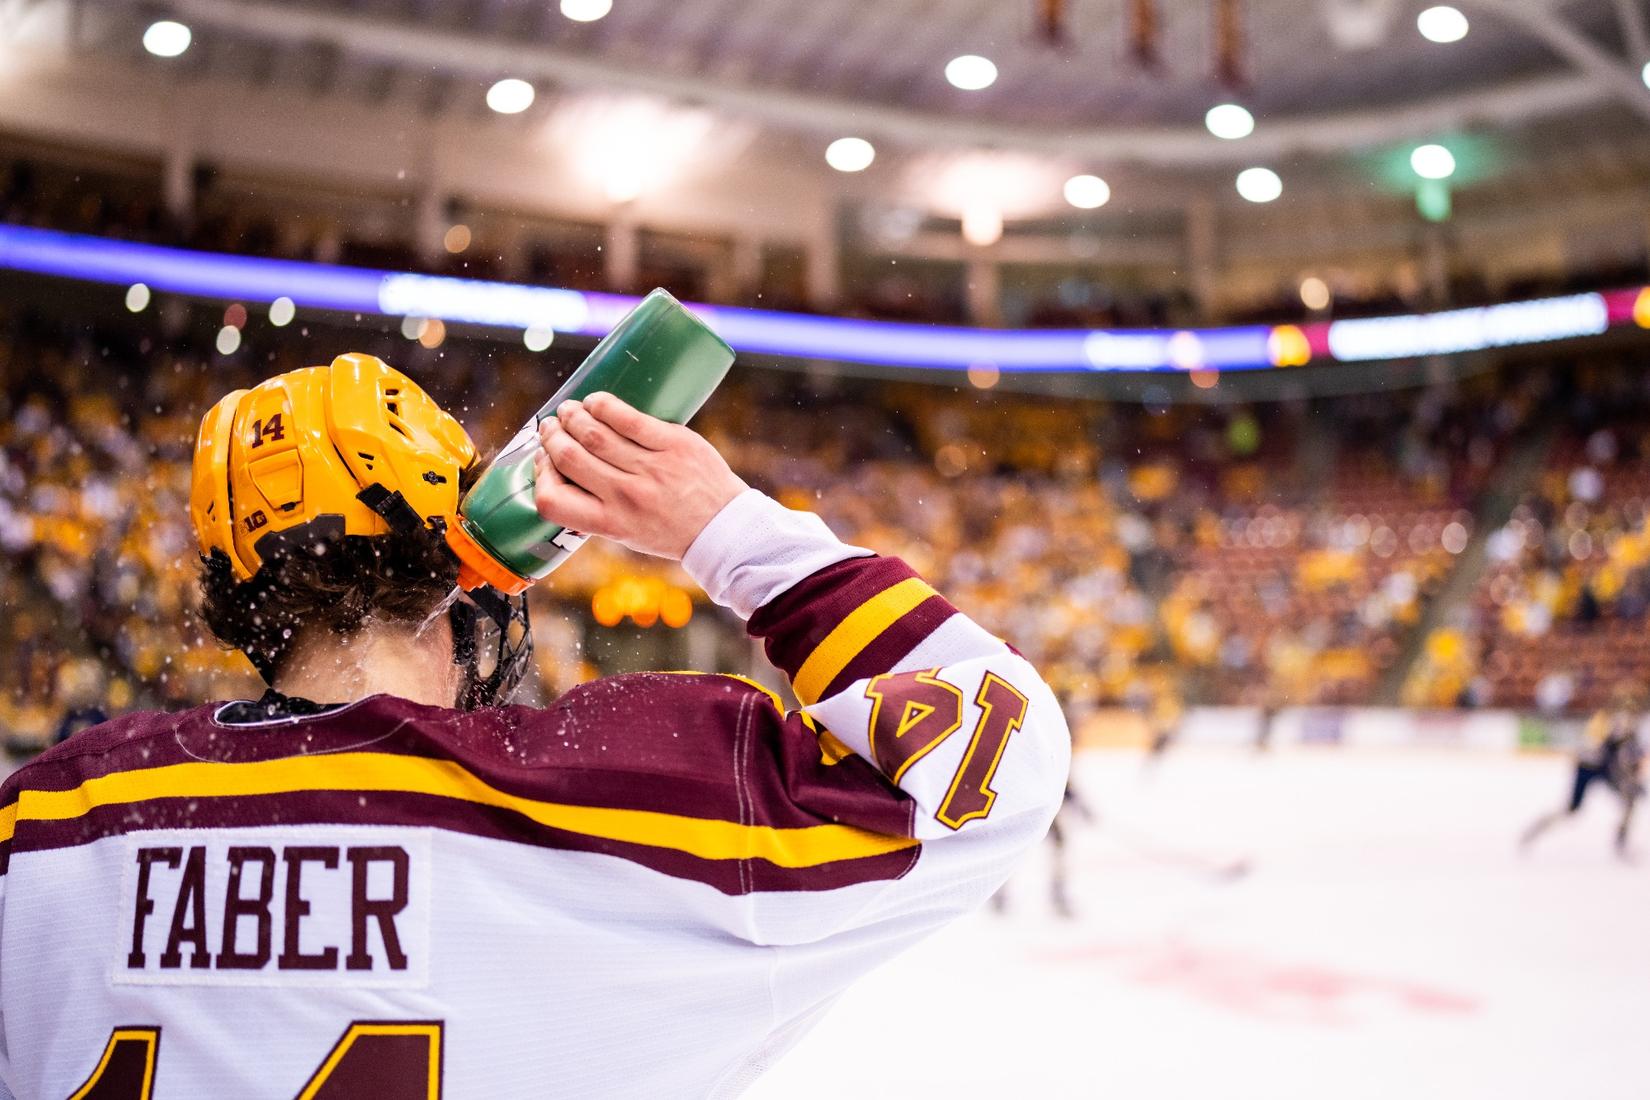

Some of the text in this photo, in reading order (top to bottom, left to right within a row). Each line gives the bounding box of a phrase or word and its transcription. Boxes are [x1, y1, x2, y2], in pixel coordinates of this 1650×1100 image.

[252, 413, 284, 449] 14
[865, 667, 1029, 831] 14
[128, 846, 409, 970] FABER
